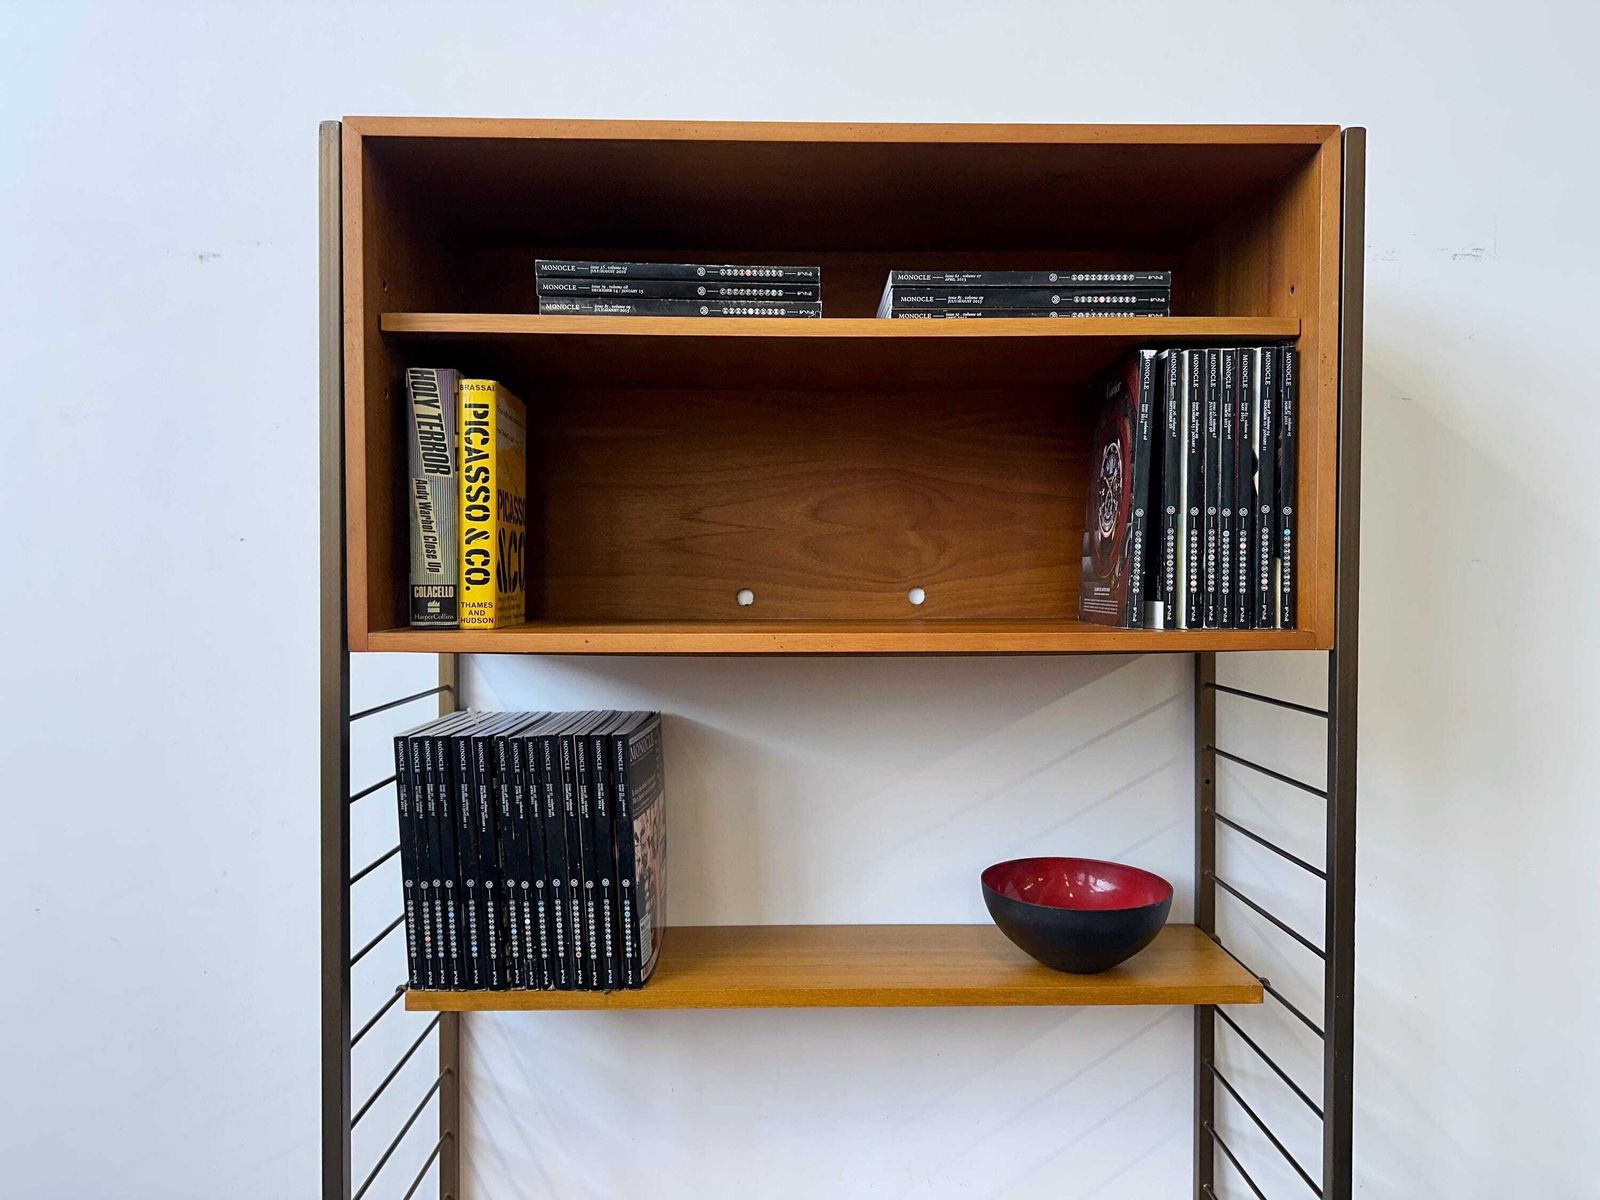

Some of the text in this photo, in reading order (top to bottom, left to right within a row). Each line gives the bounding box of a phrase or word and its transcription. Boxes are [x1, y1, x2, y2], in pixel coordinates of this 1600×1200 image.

[410, 369, 451, 475] HOLY TERROR
[415, 479, 441, 573] Andy Warhol Close Up
[465, 403, 490, 591] PICASSO & CO.
[414, 586, 454, 598] COLACELLO
